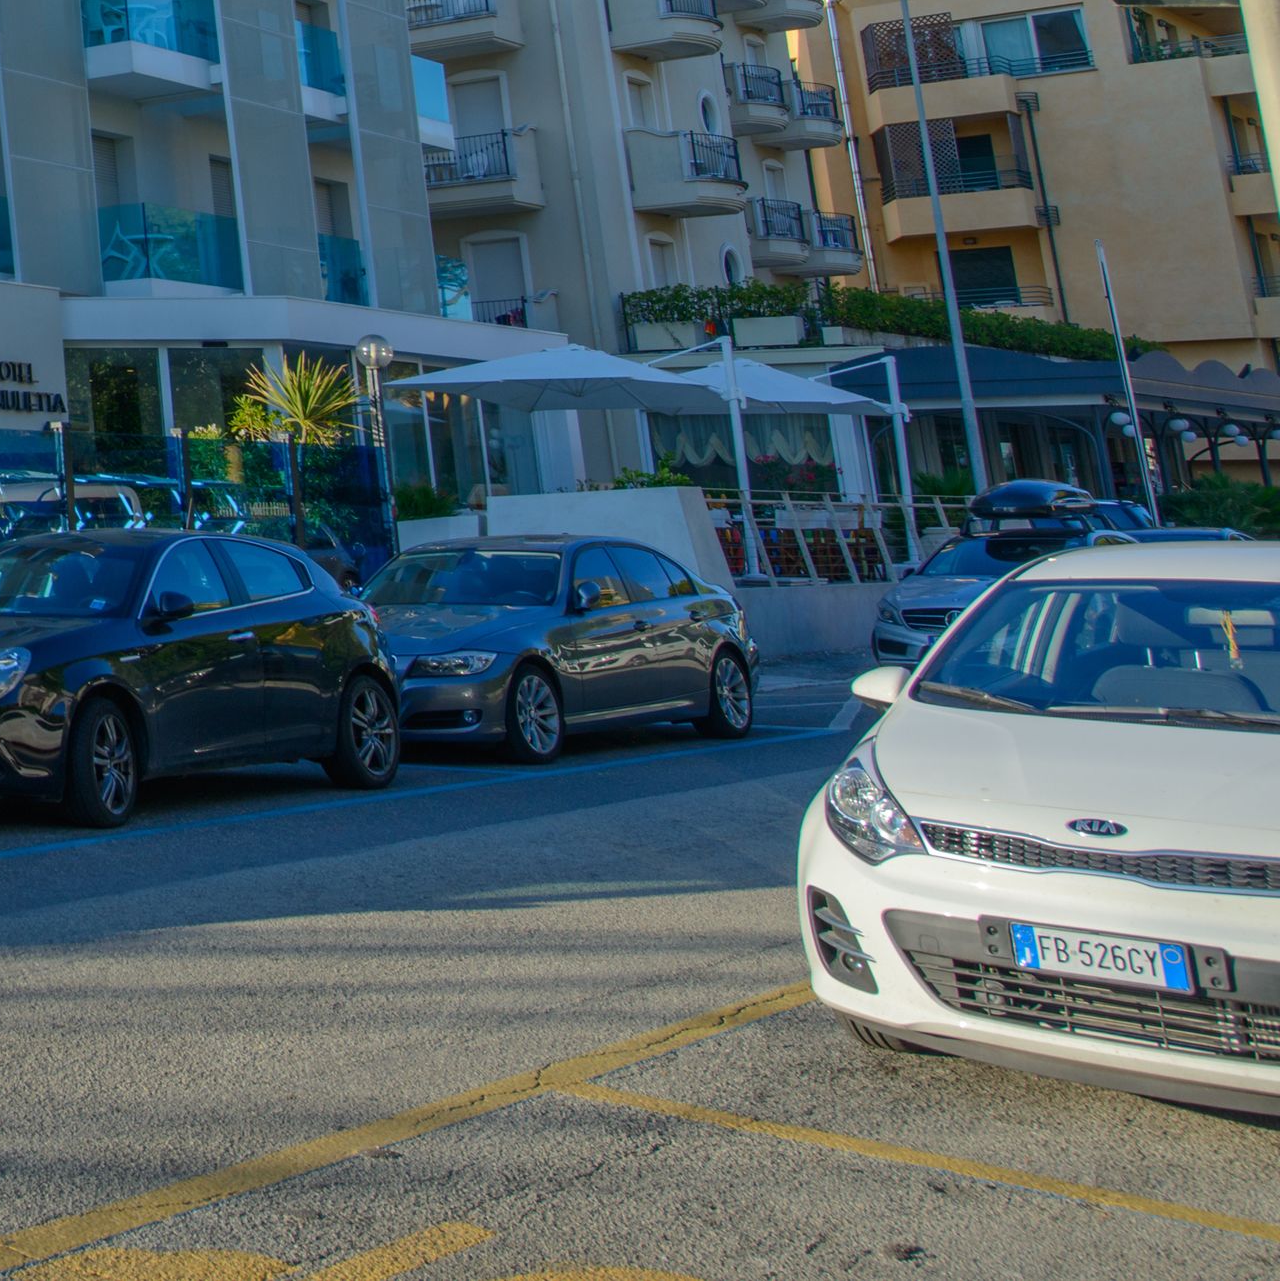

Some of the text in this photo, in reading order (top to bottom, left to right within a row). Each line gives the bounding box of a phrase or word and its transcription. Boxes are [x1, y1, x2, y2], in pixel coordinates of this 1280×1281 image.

[1075, 820, 1118, 835] KIA
[1039, 935, 1070, 963] FB
[1077, 941, 1157, 977] 526GY
